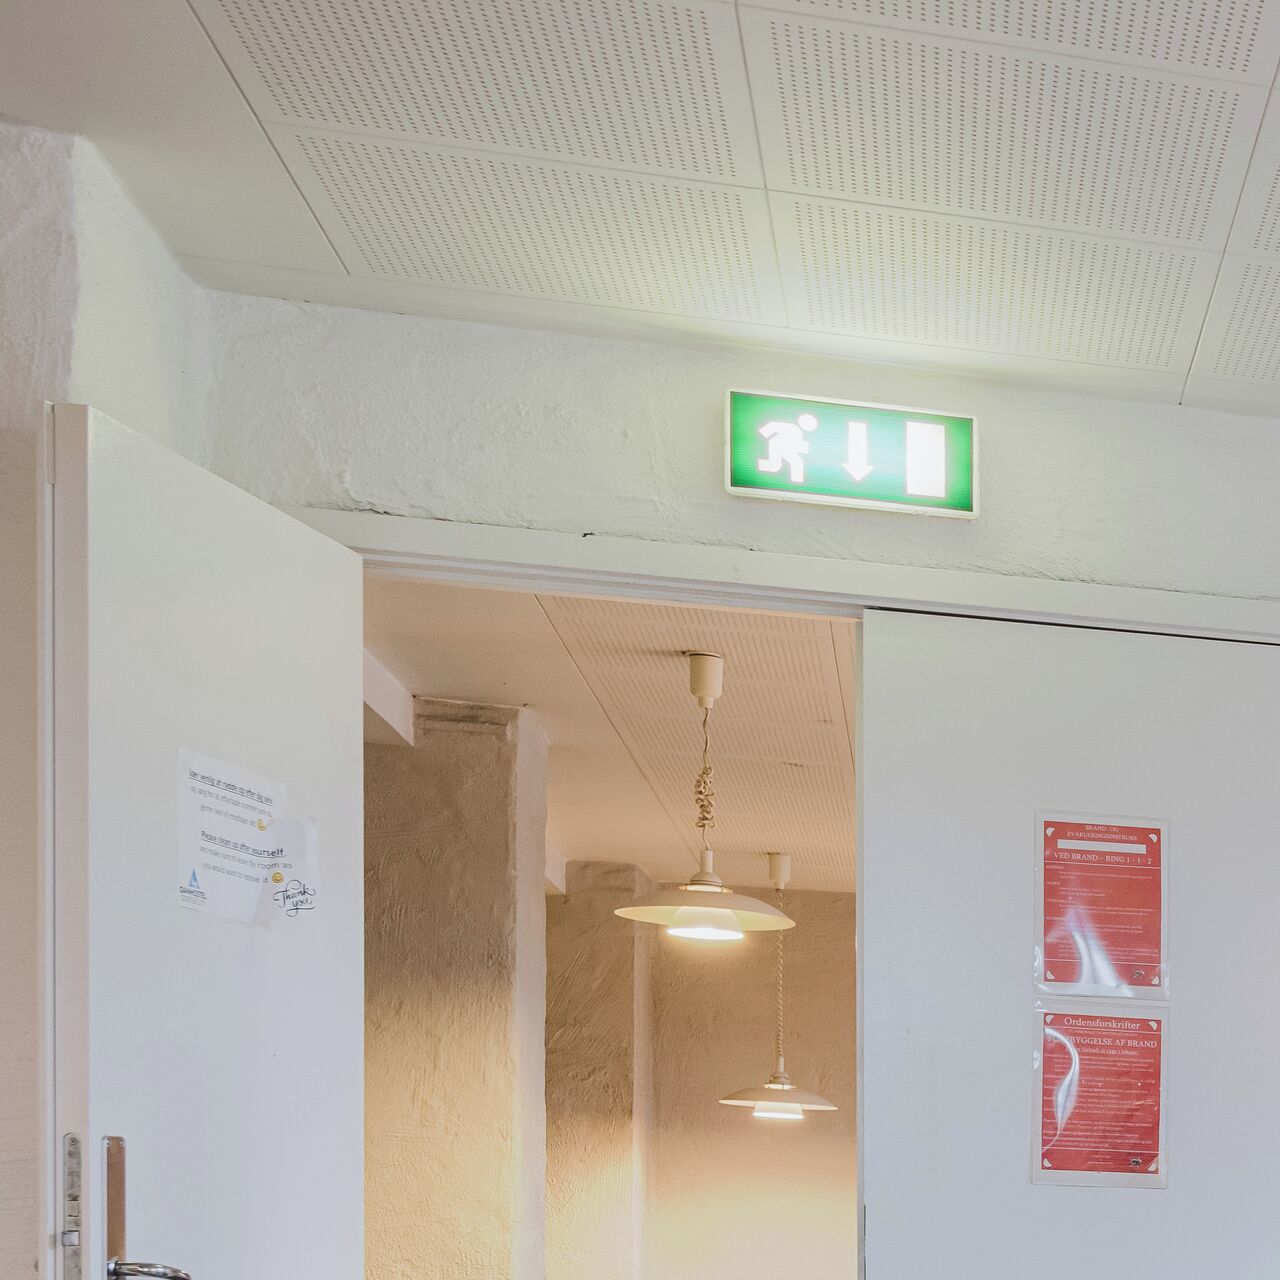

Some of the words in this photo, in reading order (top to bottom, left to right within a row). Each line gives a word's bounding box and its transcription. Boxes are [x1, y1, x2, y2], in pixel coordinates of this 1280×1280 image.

[1053, 851, 1070, 859] VED
[1071, 852, 1098, 861] BRAND
[1105, 855, 1125, 863] RING
[273, 880, 316, 908] Thank
[286, 898, 316, 917] you
[1064, 1017, 1140, 1029] Ordensforskrifter
[1114, 1039, 1126, 1047] AF
[1127, 1040, 1157, 1048] BRAND
